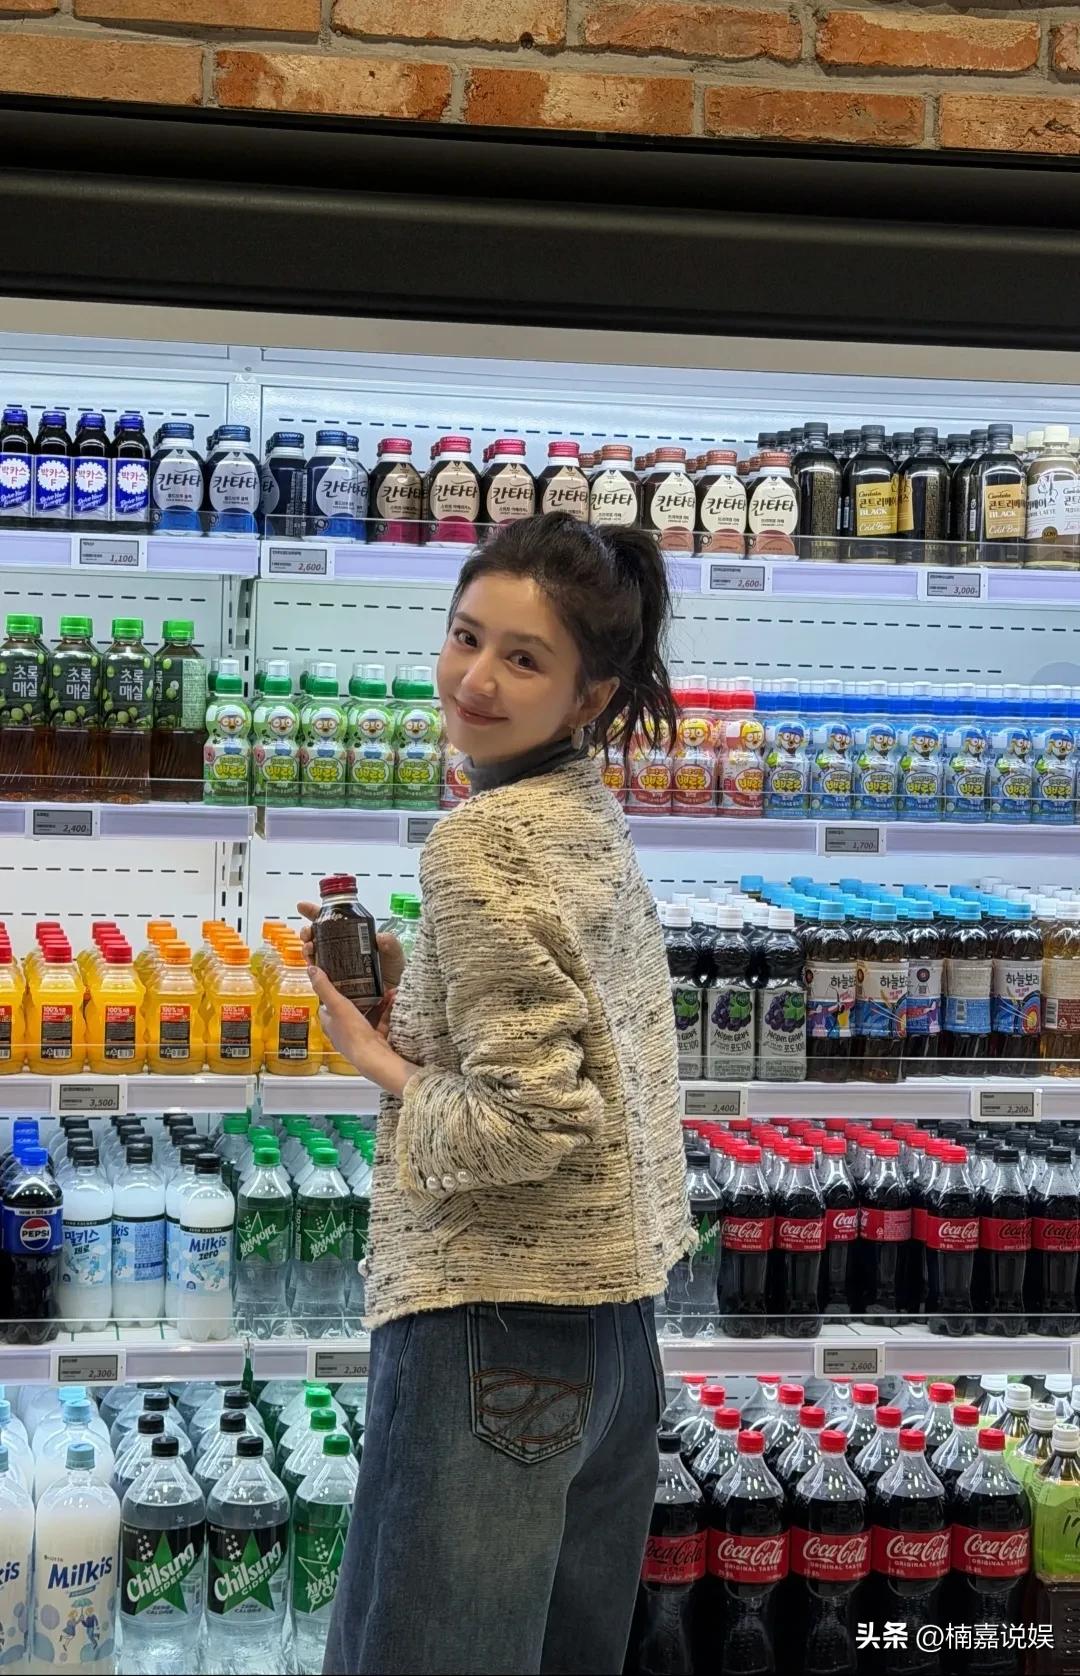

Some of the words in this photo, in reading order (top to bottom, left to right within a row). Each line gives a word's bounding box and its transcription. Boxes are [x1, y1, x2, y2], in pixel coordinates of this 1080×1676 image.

[1, 466, 27, 476] 박카스
[41, 468, 66, 479] 박카스
[79, 470, 104, 481] 박카스
[121, 472, 146, 482] 박카스
[157, 473, 201, 491] 칸타타
[213, 475, 258, 493] 칸타타
[434, 484, 478, 502] 칸타타
[490, 487, 534, 505] 칸타타
[591, 493, 633, 511] 칸타타
[752, 499, 795, 516] 칸타타
[860, 508, 887, 516] BLACK
[989, 510, 1016, 518] BLACK
[110, 555, 133, 563] 1,100
[298, 563, 320, 571] 2,600
[738, 579, 760, 587] 2,600
[13, 666, 38, 681] 초록
[67, 668, 91, 684] 초록
[120, 669, 144, 684] 초록
[13, 682, 38, 698] 매실
[67, 684, 91, 700] 매실
[119, 685, 143, 701] 매실
[63, 825, 86, 833] 2,400
[90, 1099, 113, 1107] 3,500
[712, 1104, 734, 1112] 2,400
[1006, 1105, 1028, 1113] 2,200
[22, 1230, 49, 1238] PEPSI
[722, 1220, 764, 1238] Coca-Cola
[780, 1221, 823, 1239] Coca-Cola
[64, 1230, 100, 1244] 밀키스
[189, 1236, 228, 1253] Milkis
[198, 1249, 219, 1260] zero
[850, 1362, 873, 1370] 2,600
[88, 1370, 112, 1378] 2,300
[718, 1537, 785, 1565] Coca-Cola
[802, 1536, 868, 1564] Coca-Cola
[886, 1534, 949, 1561] Coca-Cola
[964, 1533, 1029, 1561] Coca-Cola
[725, 1562, 756, 1572] ORIGINAL
[809, 1562, 843, 1570] ORIGINAL
[894, 1560, 927, 1568] ORIGINAL
[971, 1558, 1004, 1568] ORIGINAL
[48, 1557, 112, 1589] Milkis
[127, 1542, 195, 1602] Chilsung
[214, 1541, 282, 1601] Chilsung
[152, 1570, 183, 1597] CIDER
[241, 1570, 271, 1596] CIDER
